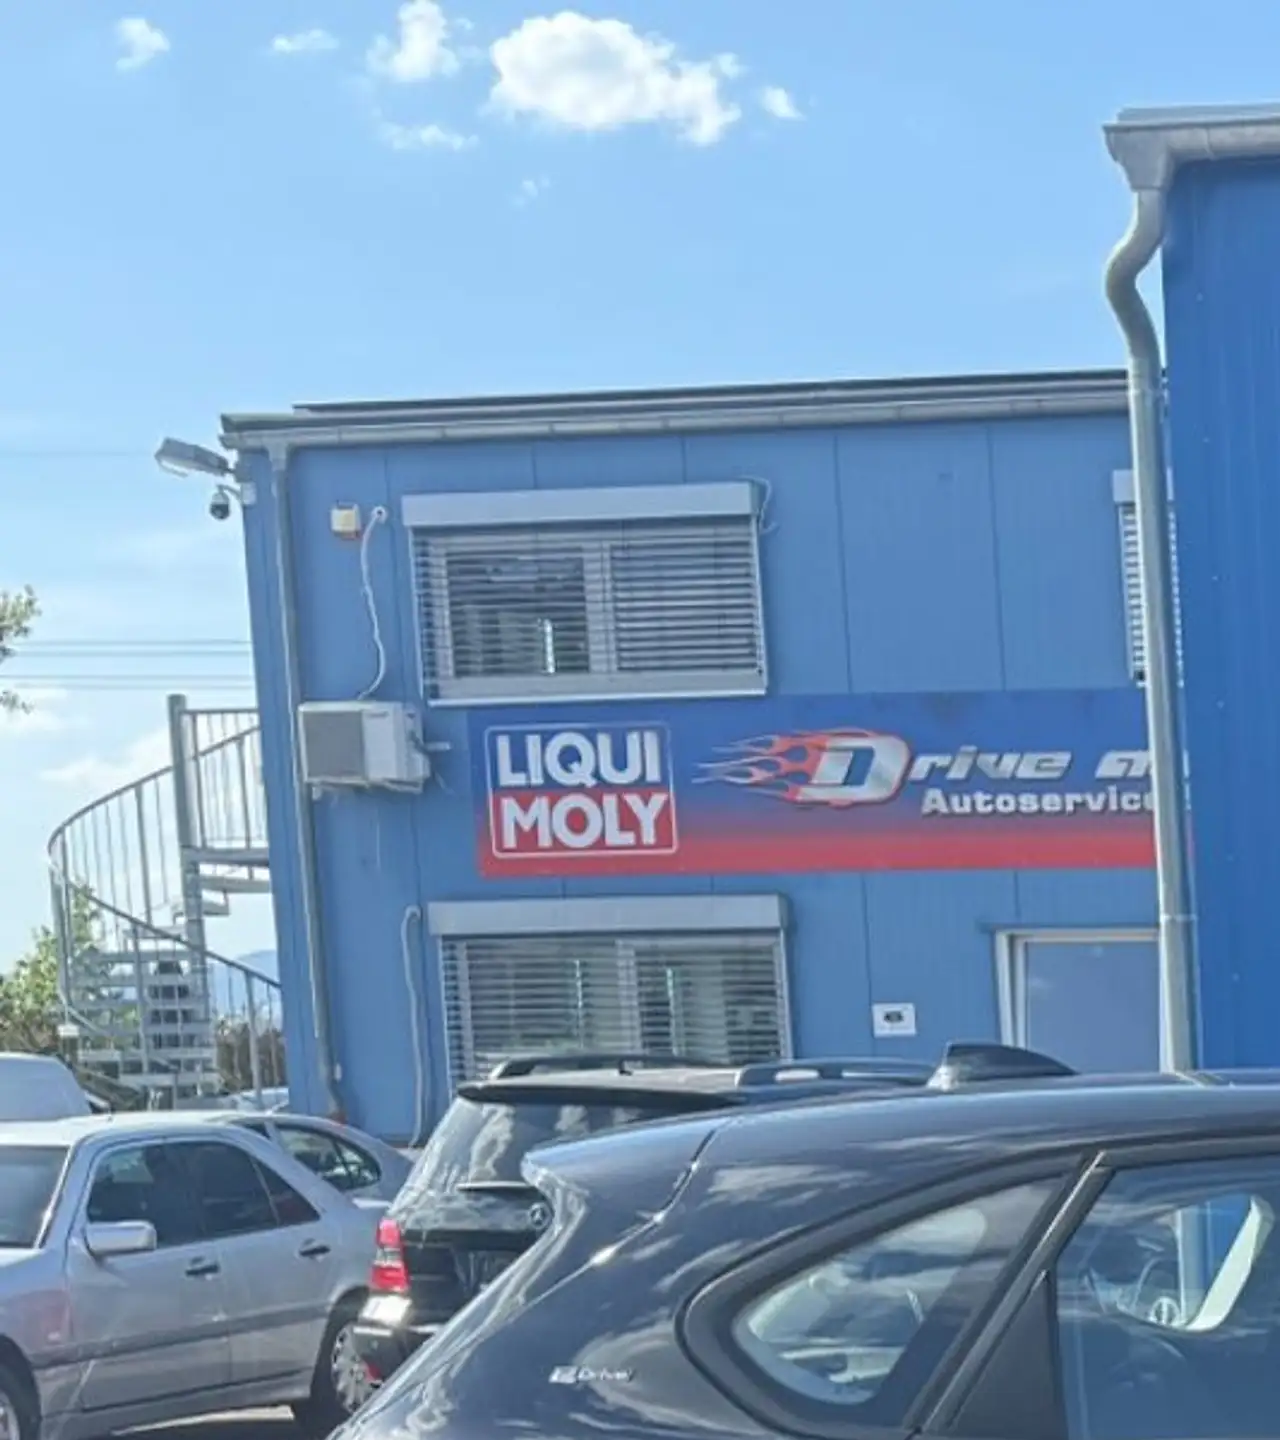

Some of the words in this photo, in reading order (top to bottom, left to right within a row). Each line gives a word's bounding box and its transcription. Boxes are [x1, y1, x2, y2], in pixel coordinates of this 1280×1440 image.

[496, 731, 662, 788] LIQUI
[799, 735, 1072, 803] Drive
[502, 793, 668, 849] MOLY
